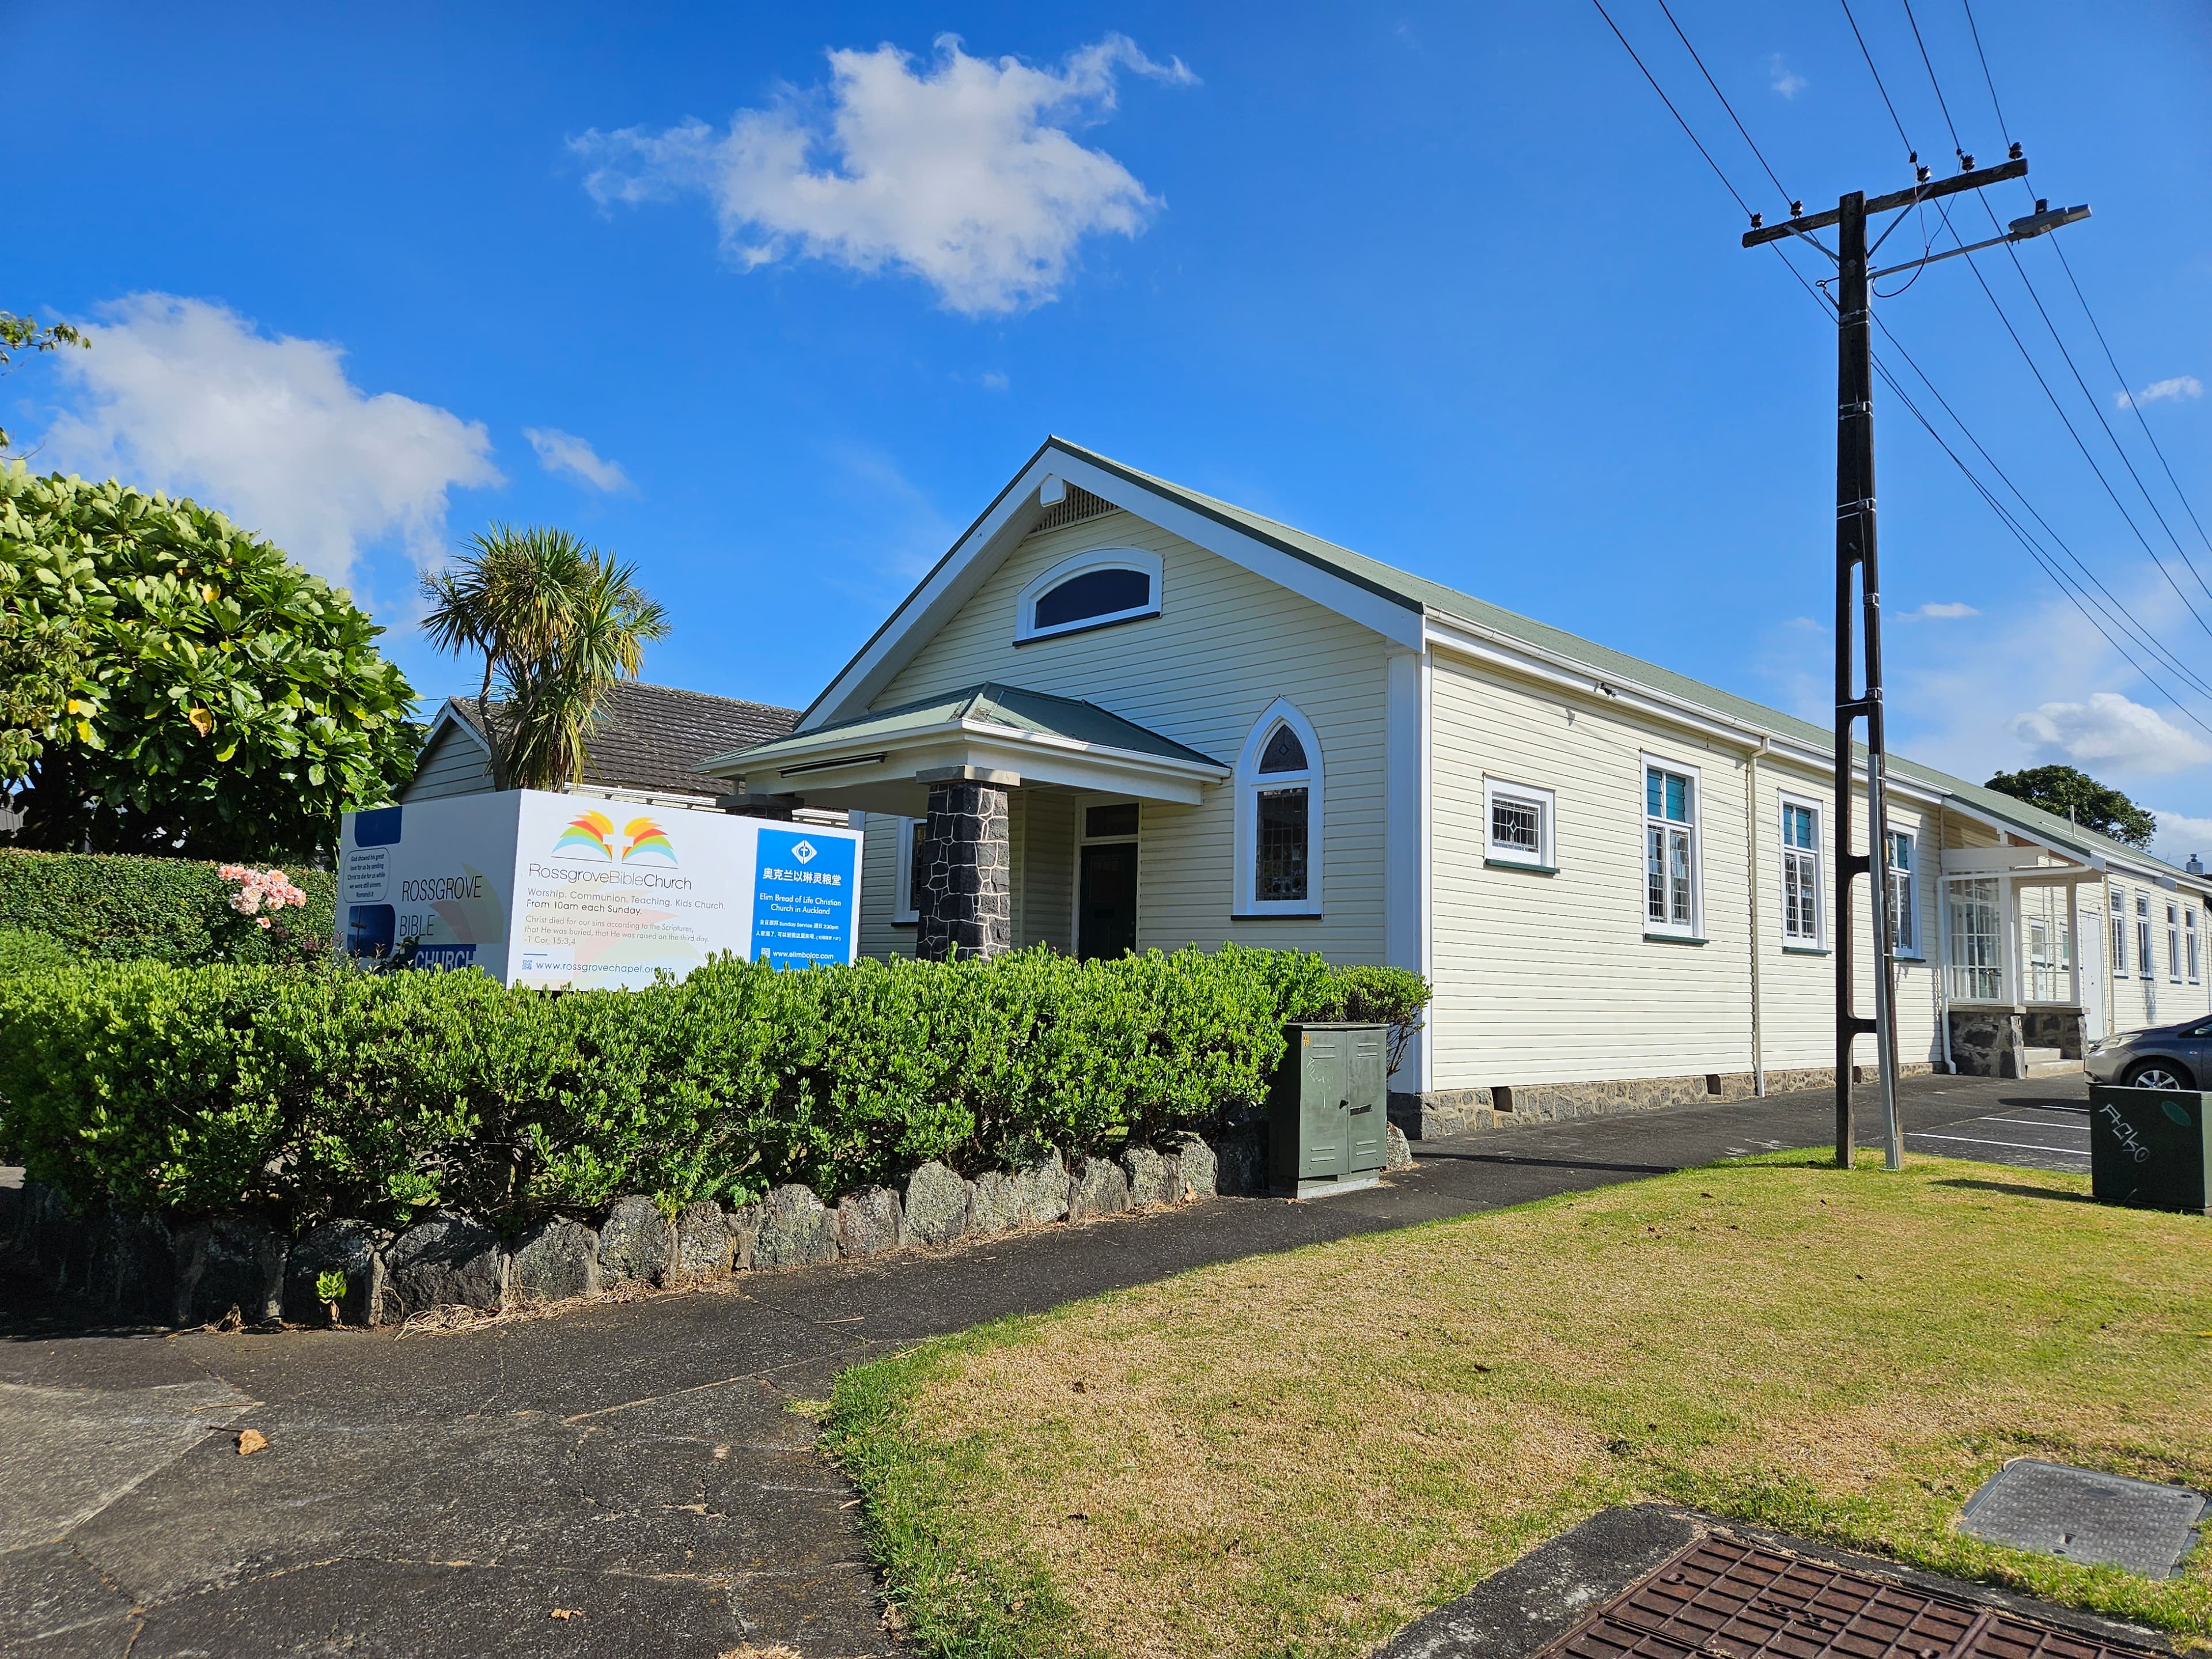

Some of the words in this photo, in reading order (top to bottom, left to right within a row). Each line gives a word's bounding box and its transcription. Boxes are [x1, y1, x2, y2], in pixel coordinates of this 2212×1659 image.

[529, 863, 692, 890] RossgroveBibleChurch
[762, 868, 842, 886] 奥克兰以琳灵粮堂
[402, 876, 483, 902] ROSSGROVE
[527, 899, 550, 908] From
[554, 901, 578, 910] 10am
[581, 904, 604, 912] each
[608, 905, 642, 916] Sunday.
[528, 888, 566, 899] Worship.
[570, 891, 628, 903] Communion.
[631, 896, 672, 907] Teaching.
[676, 899, 692, 907] Kids
[695, 901, 726, 910] Church.
[760, 893, 773, 901] Elim
[775, 894, 793, 903] Bread
[795, 895, 802, 903] of
[803, 896, 813, 904] Life
[815, 897, 842, 906] Christian
[771, 903, 793, 912] Church
[802, 906, 830, 915] Auckland
[400, 915, 435, 937] BIBLE
[541, 926, 551, 934] He
[569, 927, 593, 937] buried,
[696, 935, 709, 944] day.
[607, 922, 639, 930] according
[662, 923, 694, 933] Scriptures,
[553, 937, 576, 946] 15:3,4
[415, 950, 476, 973] CHURCH
[536, 963, 673, 974] www.rossgrovechapel.ornz
